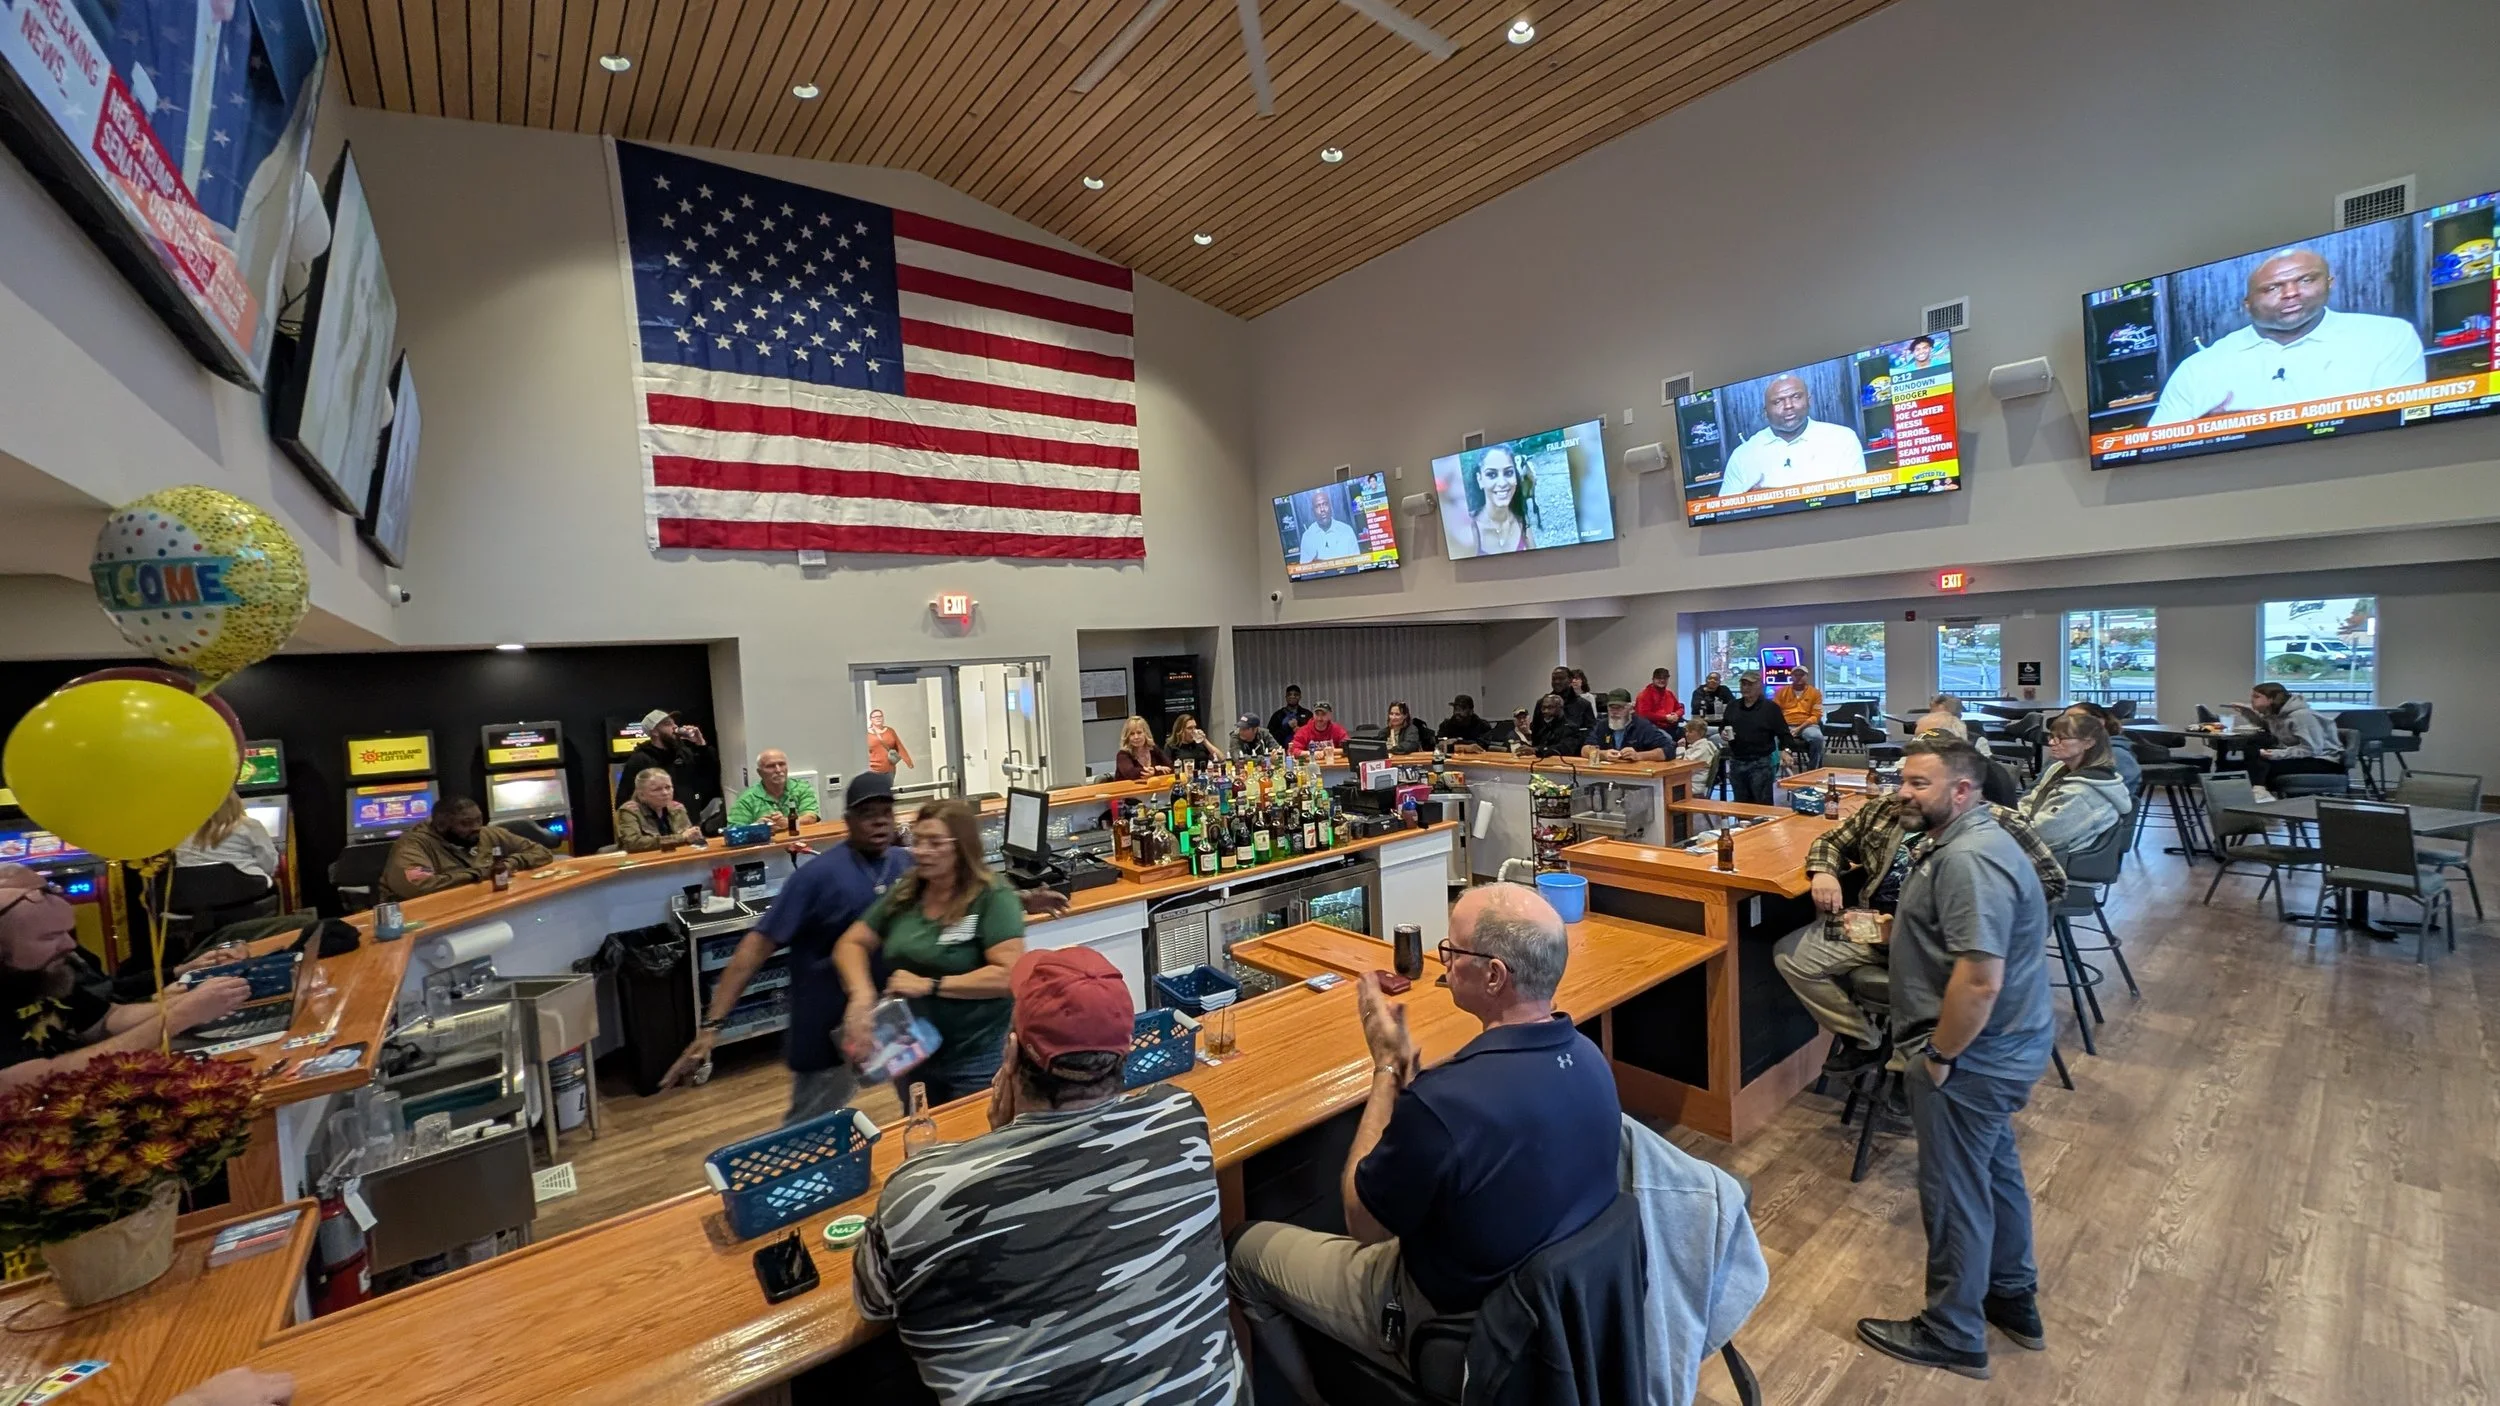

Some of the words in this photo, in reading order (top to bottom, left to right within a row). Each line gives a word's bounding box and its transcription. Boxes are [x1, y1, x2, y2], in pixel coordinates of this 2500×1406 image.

[139, 133, 175, 202] TRUMP
[1893, 378, 1935, 392] RUNDOWN
[1894, 390, 1928, 402] BOOGER
[1894, 402, 1917, 412] BOSA
[1895, 412, 1909, 421] JOE
[1911, 405, 1944, 417] CARTER
[2125, 432, 2149, 445] HOW
[2151, 425, 2194, 441] SHOULD
[2197, 413, 2267, 433] TEAMMATES
[2269, 405, 2298, 423] FEEL
[2301, 401, 2342, 418] ABOUT
[2346, 394, 2382, 411] TUA'S
[2386, 380, 2476, 405] COMMENTS?
[1896, 419, 1923, 430] MESSI
[1897, 427, 1930, 439] ERRORS
[1898, 440, 1913, 449] BIG
[1914, 434, 1942, 446] FINISH
[1898, 448, 1920, 458] SEAN
[1922, 442, 1952, 454] PAYTON
[1899, 455, 1930, 466] ROOKIE
[1912, 471, 1935, 480] TWISTED
[1706, 500, 1720, 510] HOW
[1722, 497, 1746, 508] SHOULD
[1746, 491, 1784, 503] TEAMMATES
[1785, 488, 1801, 497] FEEL
[1802, 484, 1824, 495] ABOUT
[1823, 481, 1846, 491] TUA'S
[1942, 574, 1963, 589] EXIT
[944, 595, 967, 615] EXIT
[381, 754, 415, 762] LOTTERY
